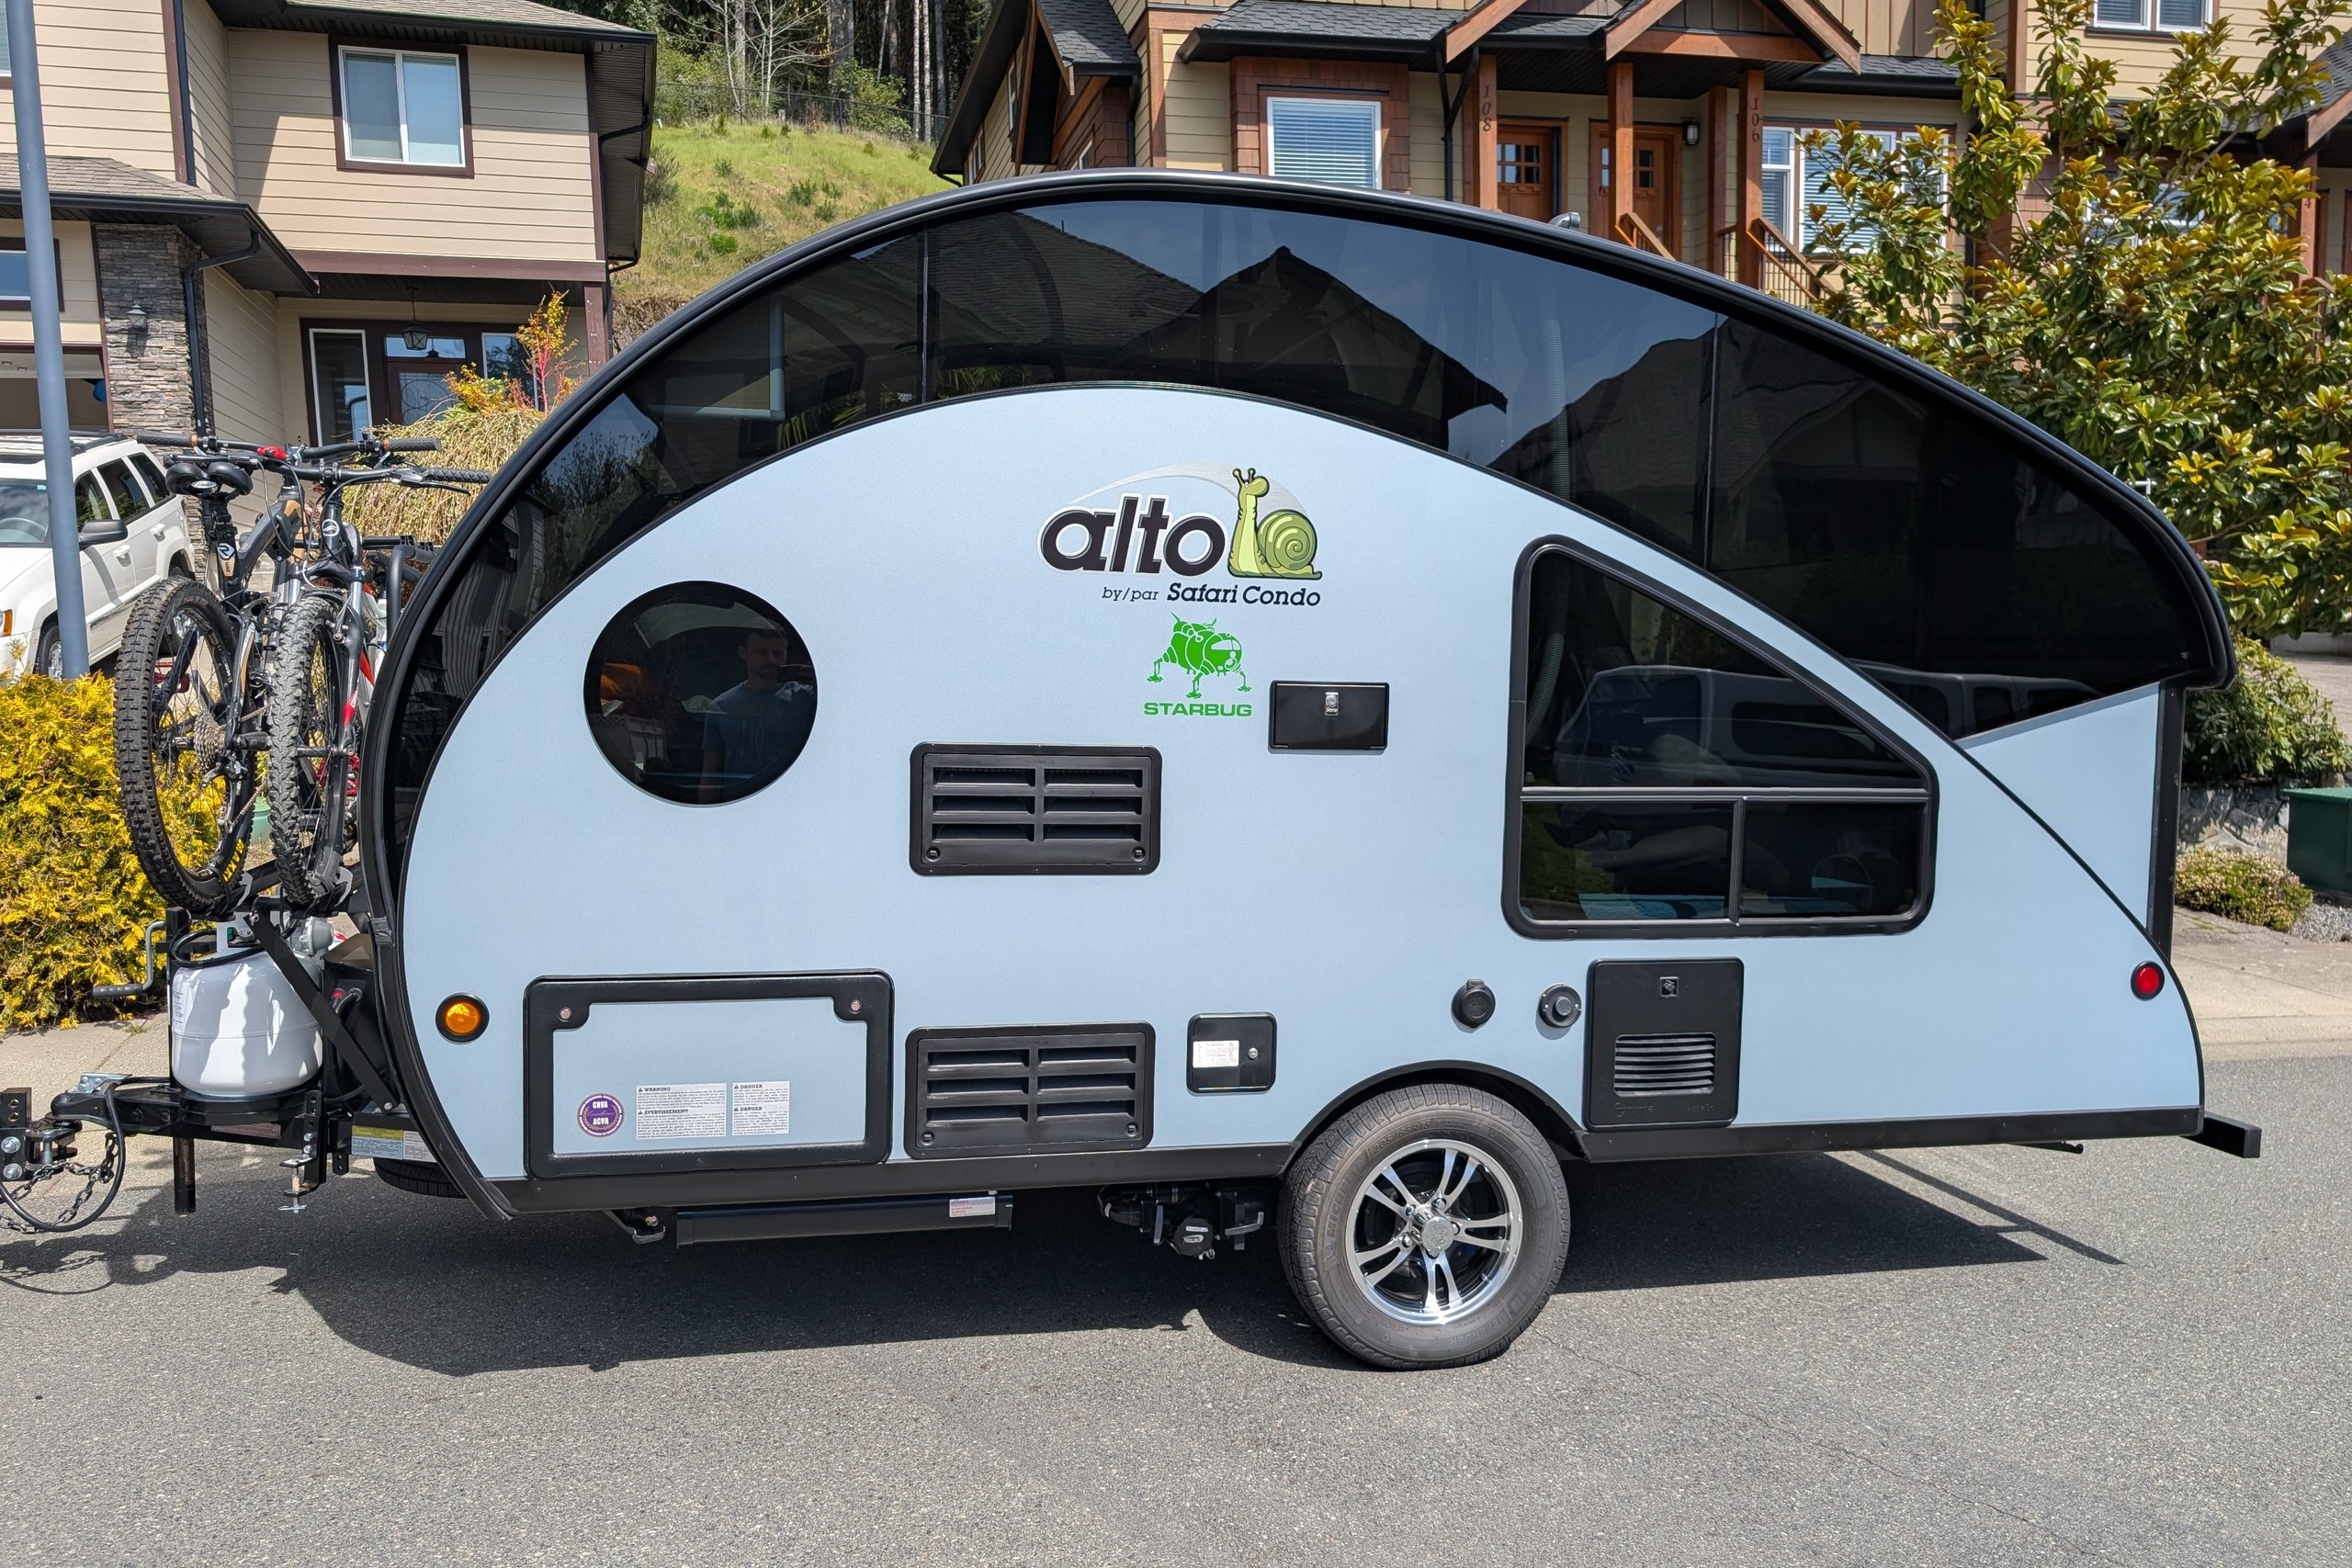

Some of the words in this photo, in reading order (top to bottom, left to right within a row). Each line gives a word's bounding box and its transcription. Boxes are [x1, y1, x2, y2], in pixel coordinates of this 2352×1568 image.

[1483, 85, 1492, 132] 108
[1751, 96, 1760, 143] 106
[1040, 495, 1226, 577] alto
[1102, 586, 1159, 603] by/par
[1166, 581, 1238, 604] Safari
[1242, 585, 1321, 606] Condo
[1143, 701, 1252, 716] STARBUG
